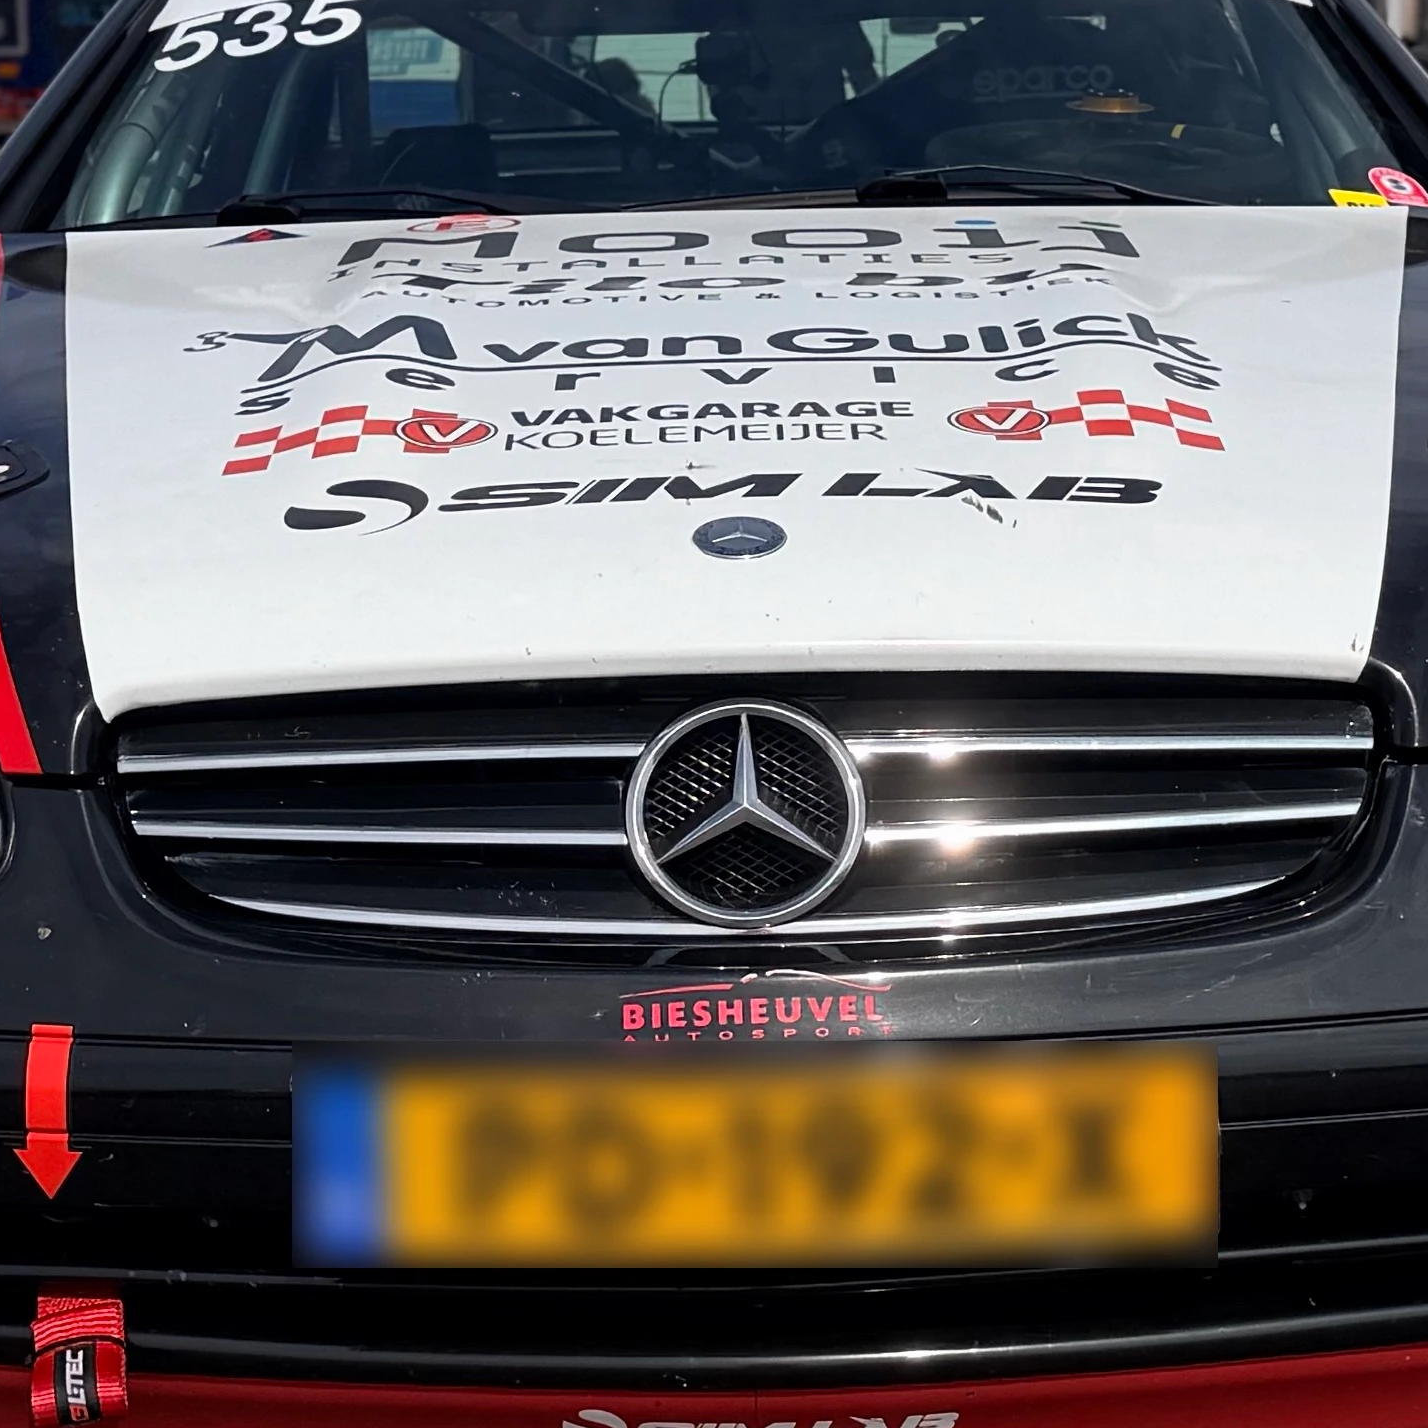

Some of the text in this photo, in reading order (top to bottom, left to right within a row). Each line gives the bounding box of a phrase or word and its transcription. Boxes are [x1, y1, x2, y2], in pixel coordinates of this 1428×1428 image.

[361, 276, 1112, 309] AUTOMOTIVE & LOGISTIEK
[510, 399, 915, 428] VAKGARAGE
[503, 422, 889, 452] KOELEMEIJER
[438, 467, 1164, 513] SIM LAB
[622, 994, 884, 1030] BIESHEUVEL
[624, 1025, 896, 1042] AUTOSPORT
